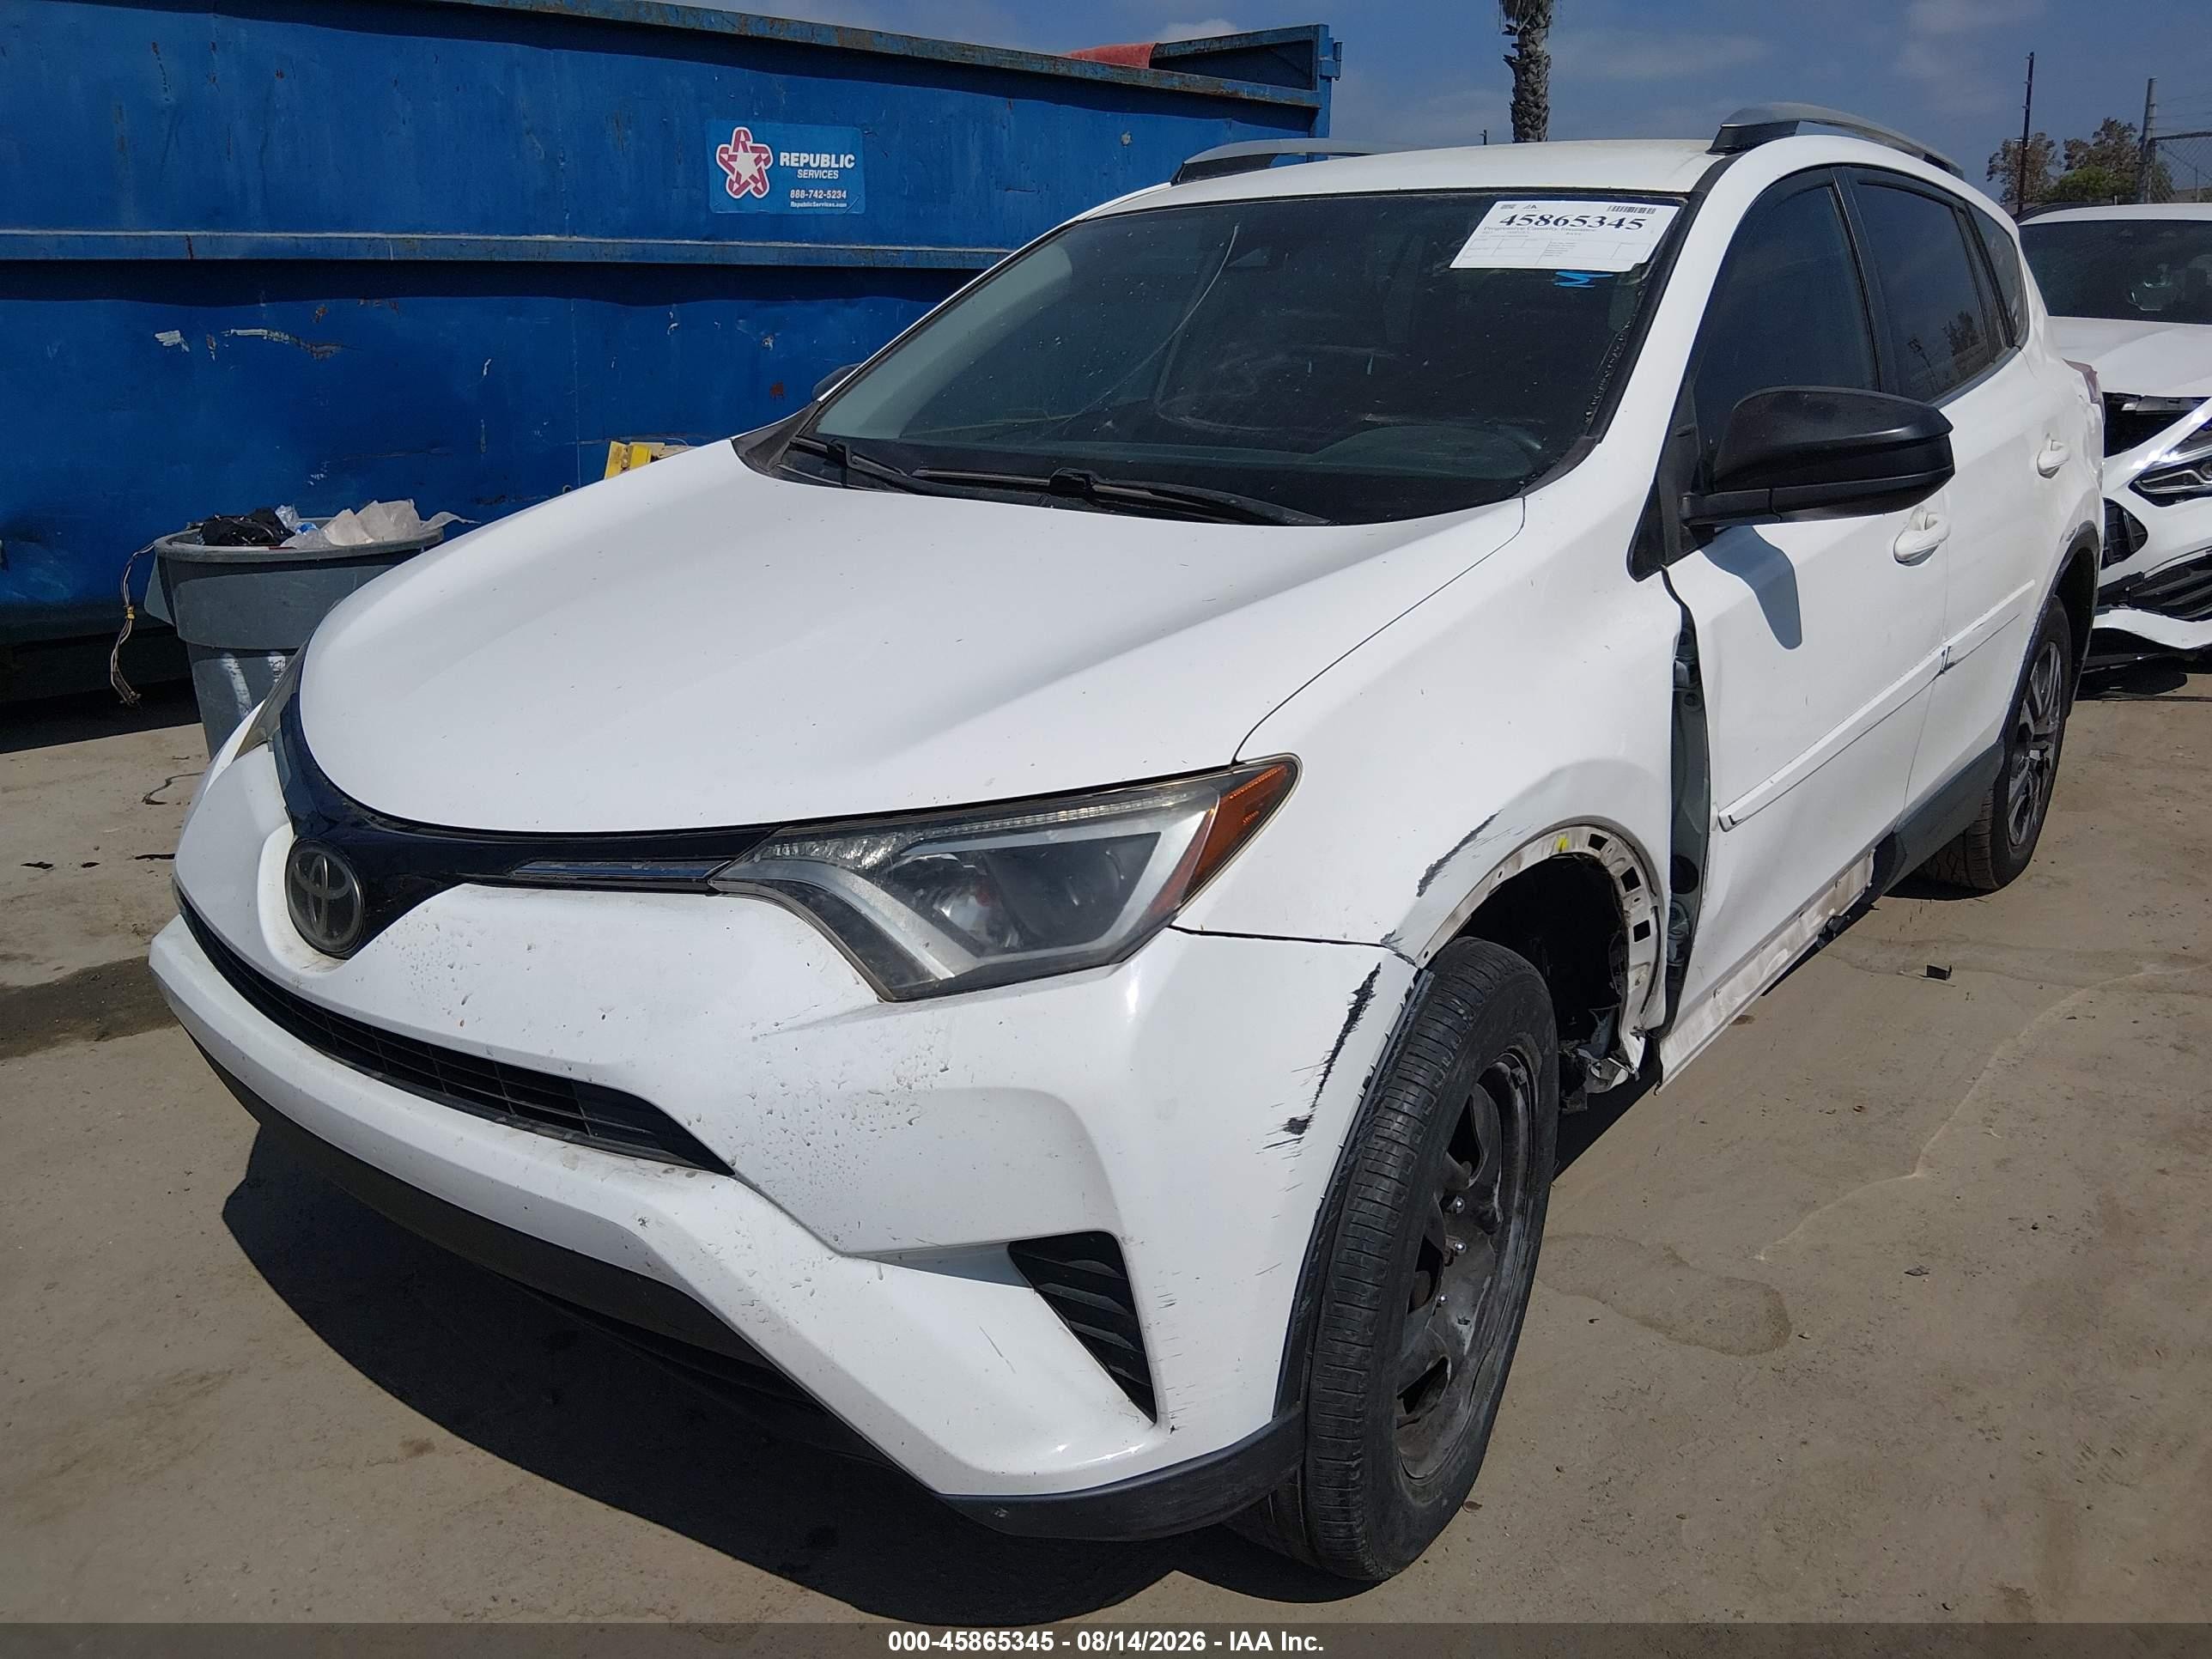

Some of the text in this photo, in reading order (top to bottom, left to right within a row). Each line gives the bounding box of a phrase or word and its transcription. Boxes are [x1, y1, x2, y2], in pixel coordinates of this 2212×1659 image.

[780, 151, 855, 169] REPUBLIC
[797, 169, 839, 179] SERVICES
[789, 189, 847, 199] 888-742-5234
[1499, 214, 1647, 230] 45865345
